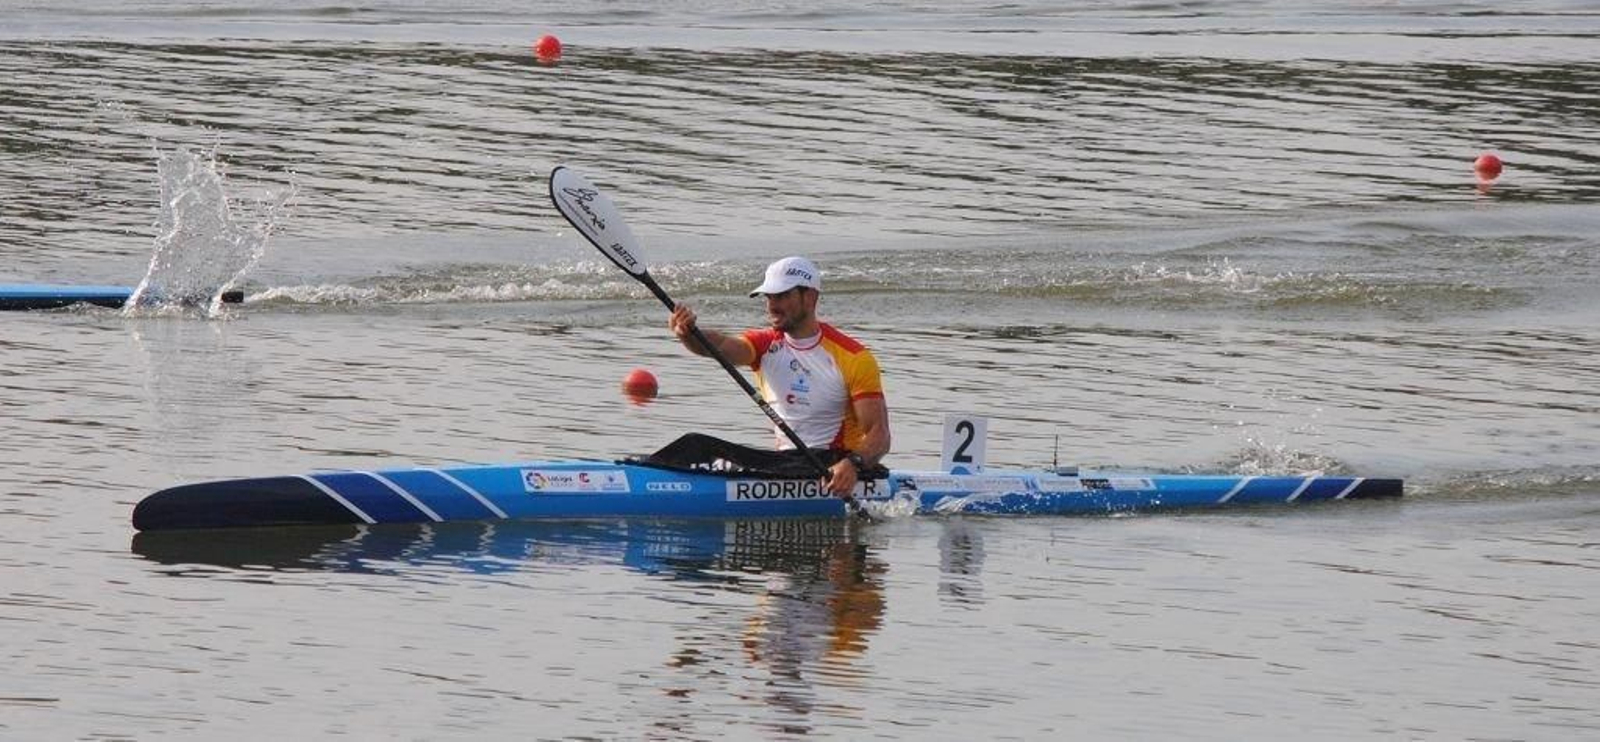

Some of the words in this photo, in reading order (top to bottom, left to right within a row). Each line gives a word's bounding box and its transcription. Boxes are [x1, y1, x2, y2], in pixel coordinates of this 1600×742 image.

[952, 419, 975, 463] 2
[648, 482, 690, 491] NELO
[736, 481, 857, 500] RODRIGU
